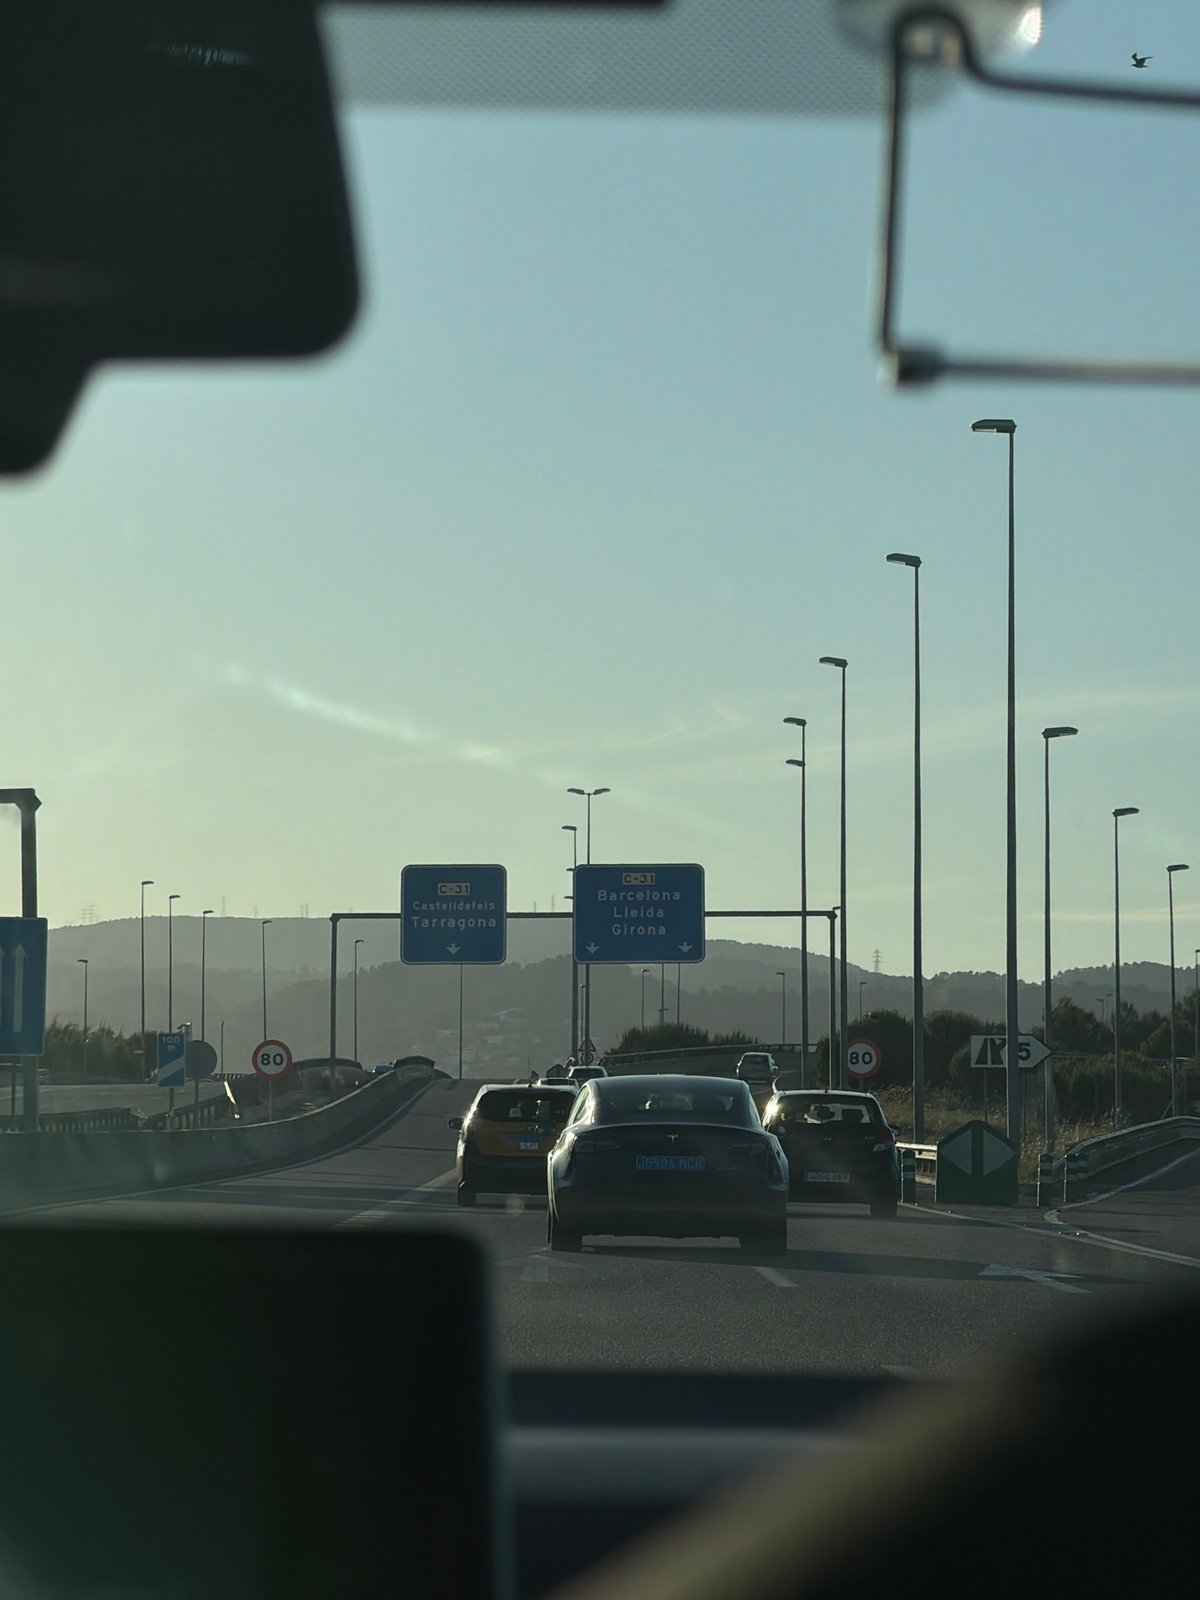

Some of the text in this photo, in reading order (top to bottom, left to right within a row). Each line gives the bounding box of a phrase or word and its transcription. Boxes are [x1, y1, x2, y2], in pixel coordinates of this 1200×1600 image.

[624, 874, 655, 884] C-31
[439, 884, 469, 894] C-31
[597, 890, 681, 901] Barcelona
[412, 901, 496, 911] Castelldefels
[613, 907, 664, 918] Lleida
[411, 916, 497, 931] Tarragona
[612, 924, 666, 935] Girona
[162, 1036, 180, 1044] 100
[260, 1053, 284, 1065] 80
[848, 1051, 873, 1064] 80
